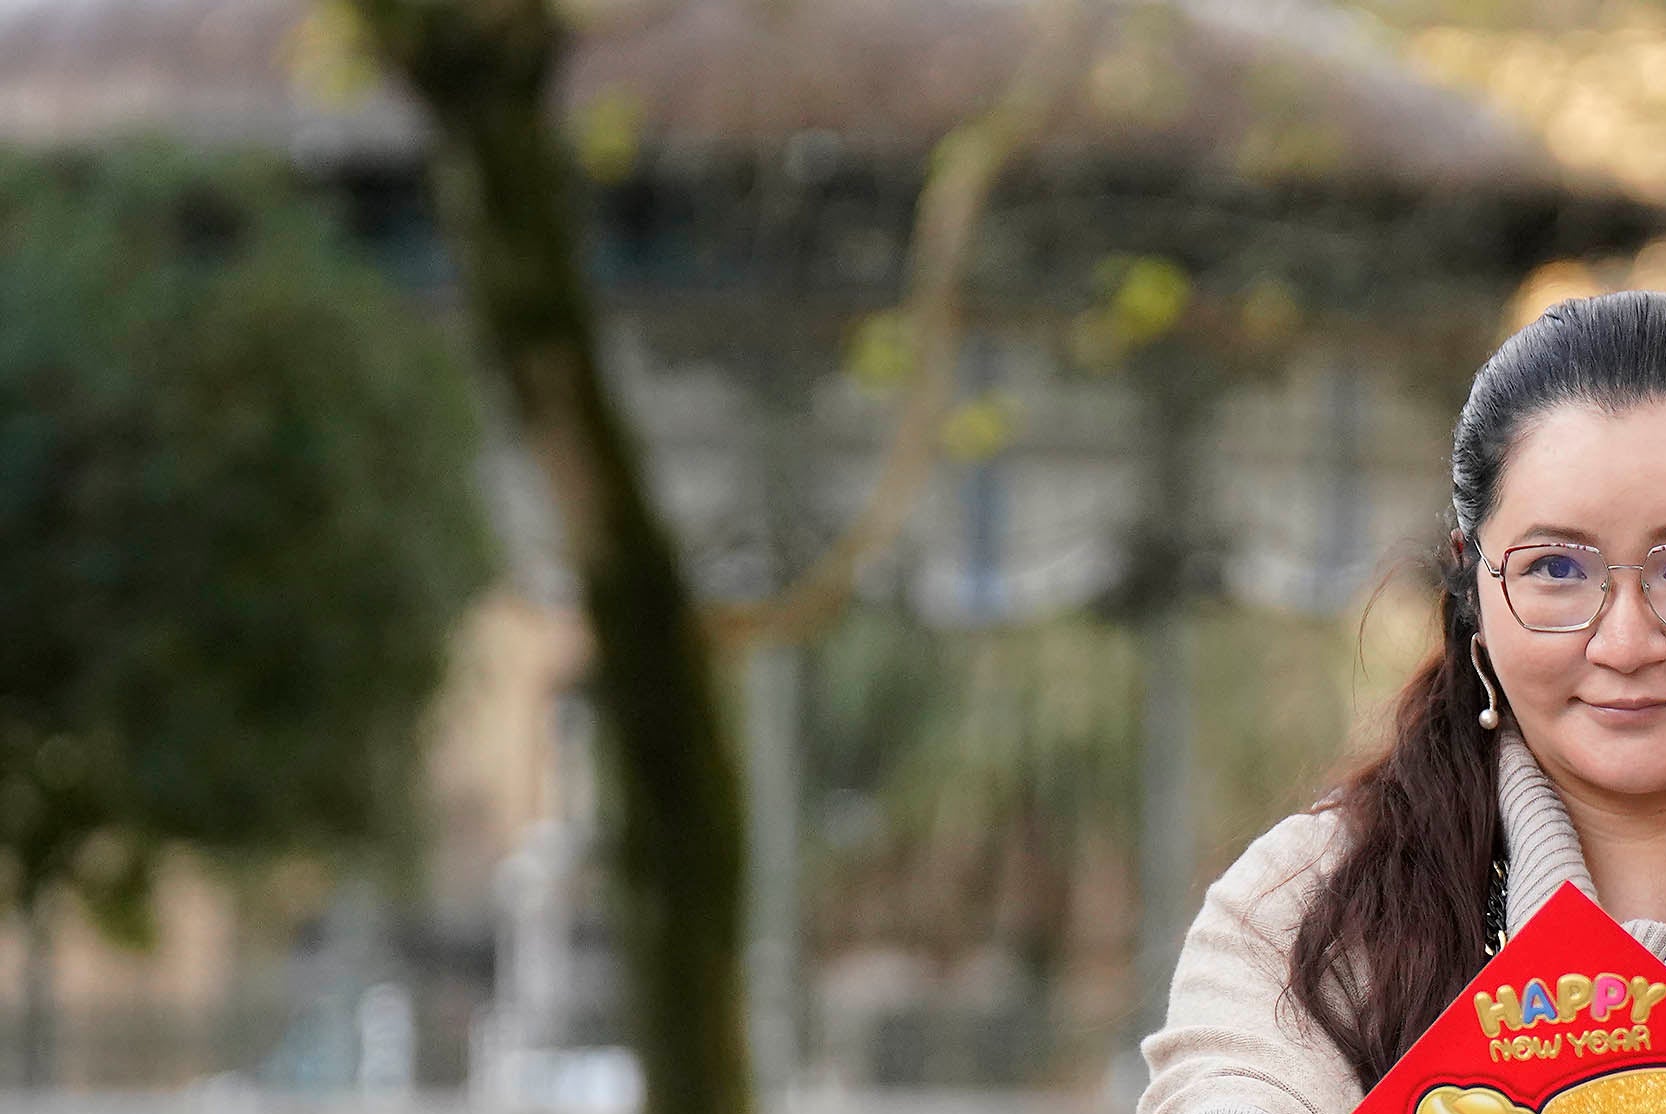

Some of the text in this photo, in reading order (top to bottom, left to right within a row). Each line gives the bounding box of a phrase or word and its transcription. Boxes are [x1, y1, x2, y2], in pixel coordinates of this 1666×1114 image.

[1473, 973, 1666, 1037] HAPPY
[1489, 1025, 1651, 1062] NEW YEAR
